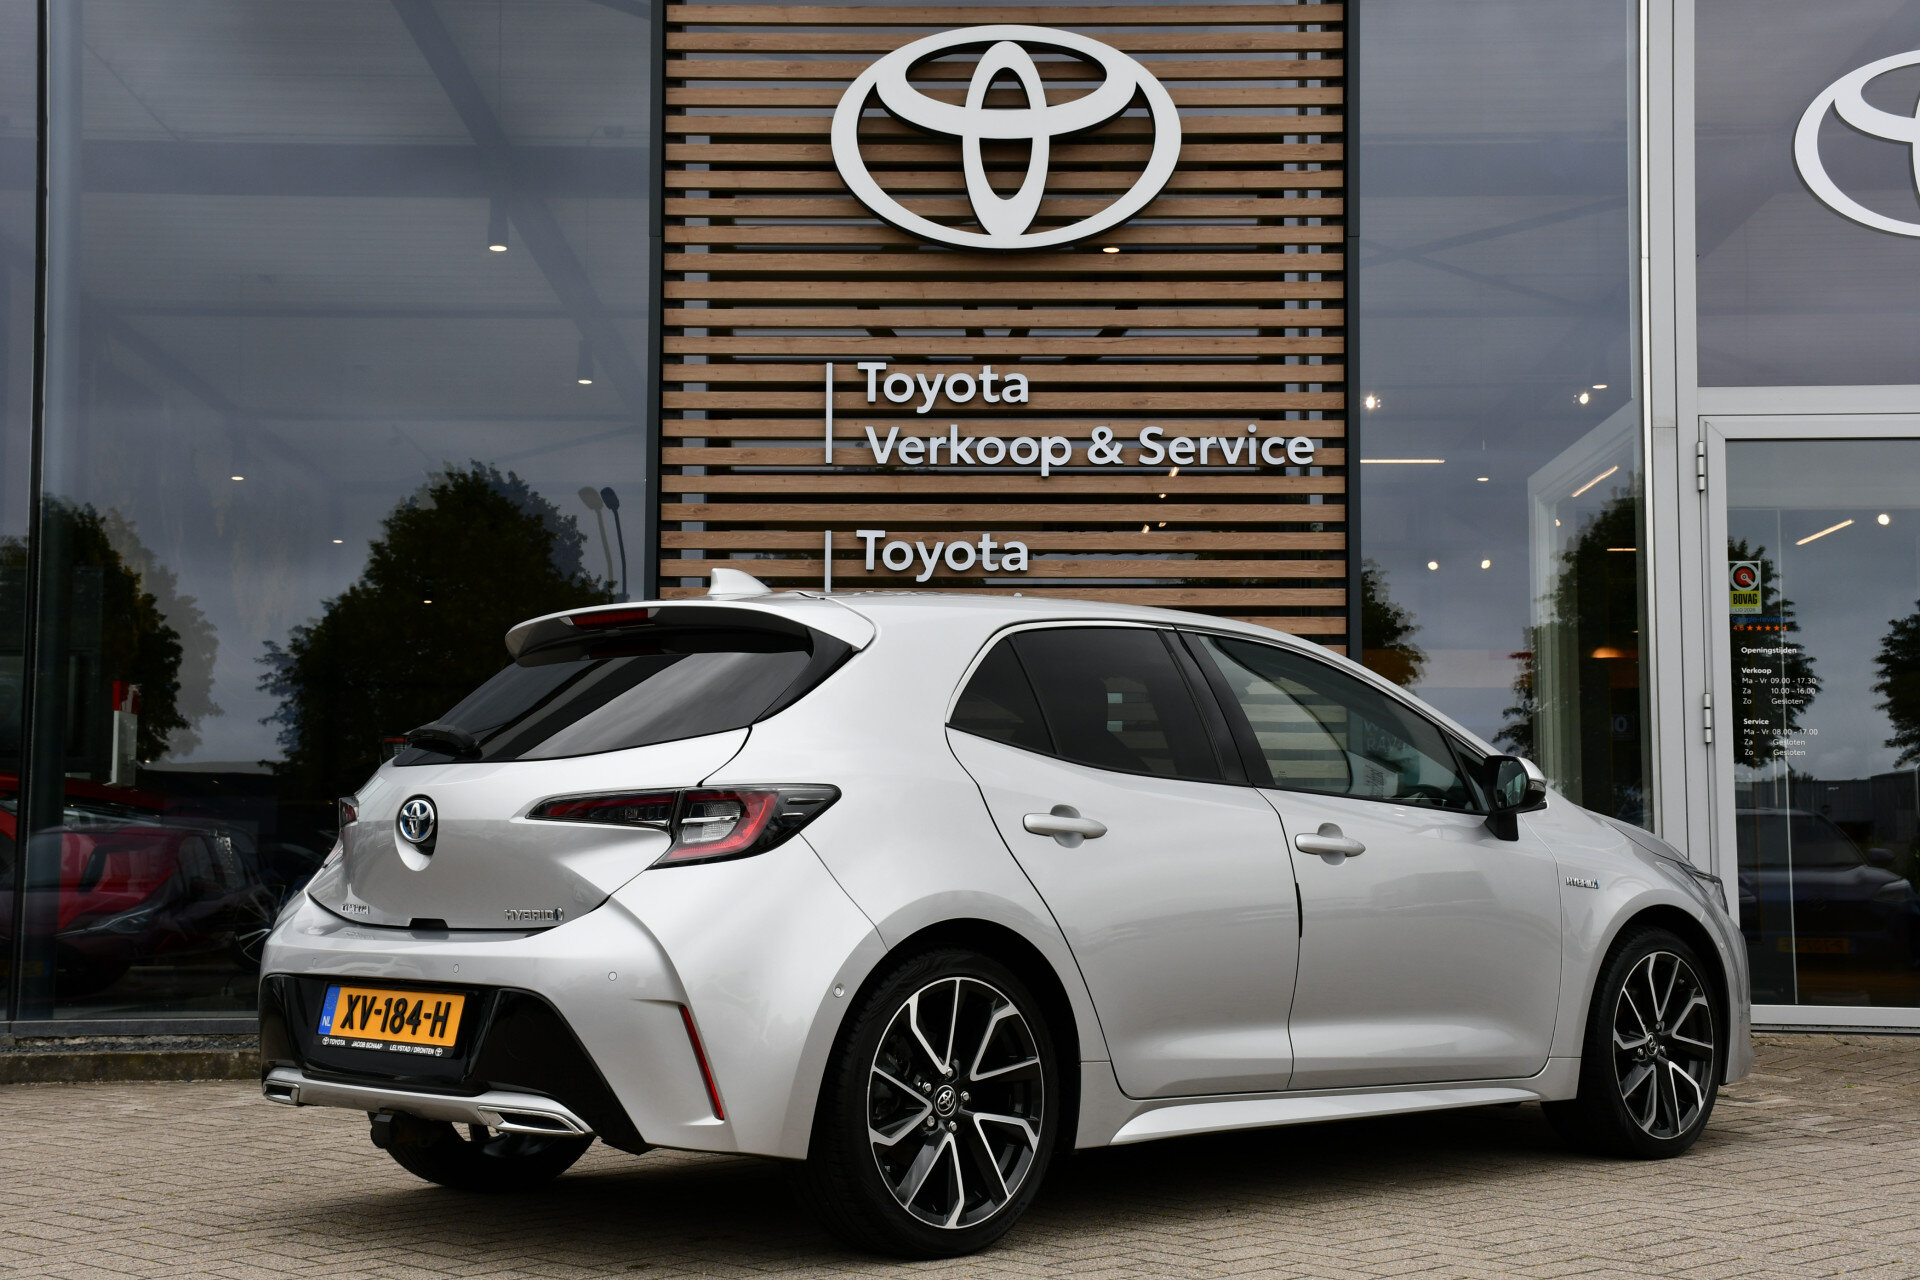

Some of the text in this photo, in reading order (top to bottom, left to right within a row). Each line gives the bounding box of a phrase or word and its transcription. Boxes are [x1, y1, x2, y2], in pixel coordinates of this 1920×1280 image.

[857, 362, 1029, 414] Toyota
[865, 423, 1315, 477] Verkoop & Service
[856, 529, 1029, 583] Toyota
[1733, 593, 1758, 605] BOVAG
[1741, 646, 1797, 655] Openingstijden
[1741, 667, 1772, 675] Verkoop
[1772, 738, 1806, 746] Gesloten
[504, 909, 554, 921] HYBRID
[322, 1015, 331, 1027] NL
[340, 994, 452, 1038] XV-184-H
[329, 1038, 346, 1046] TOYOTA
